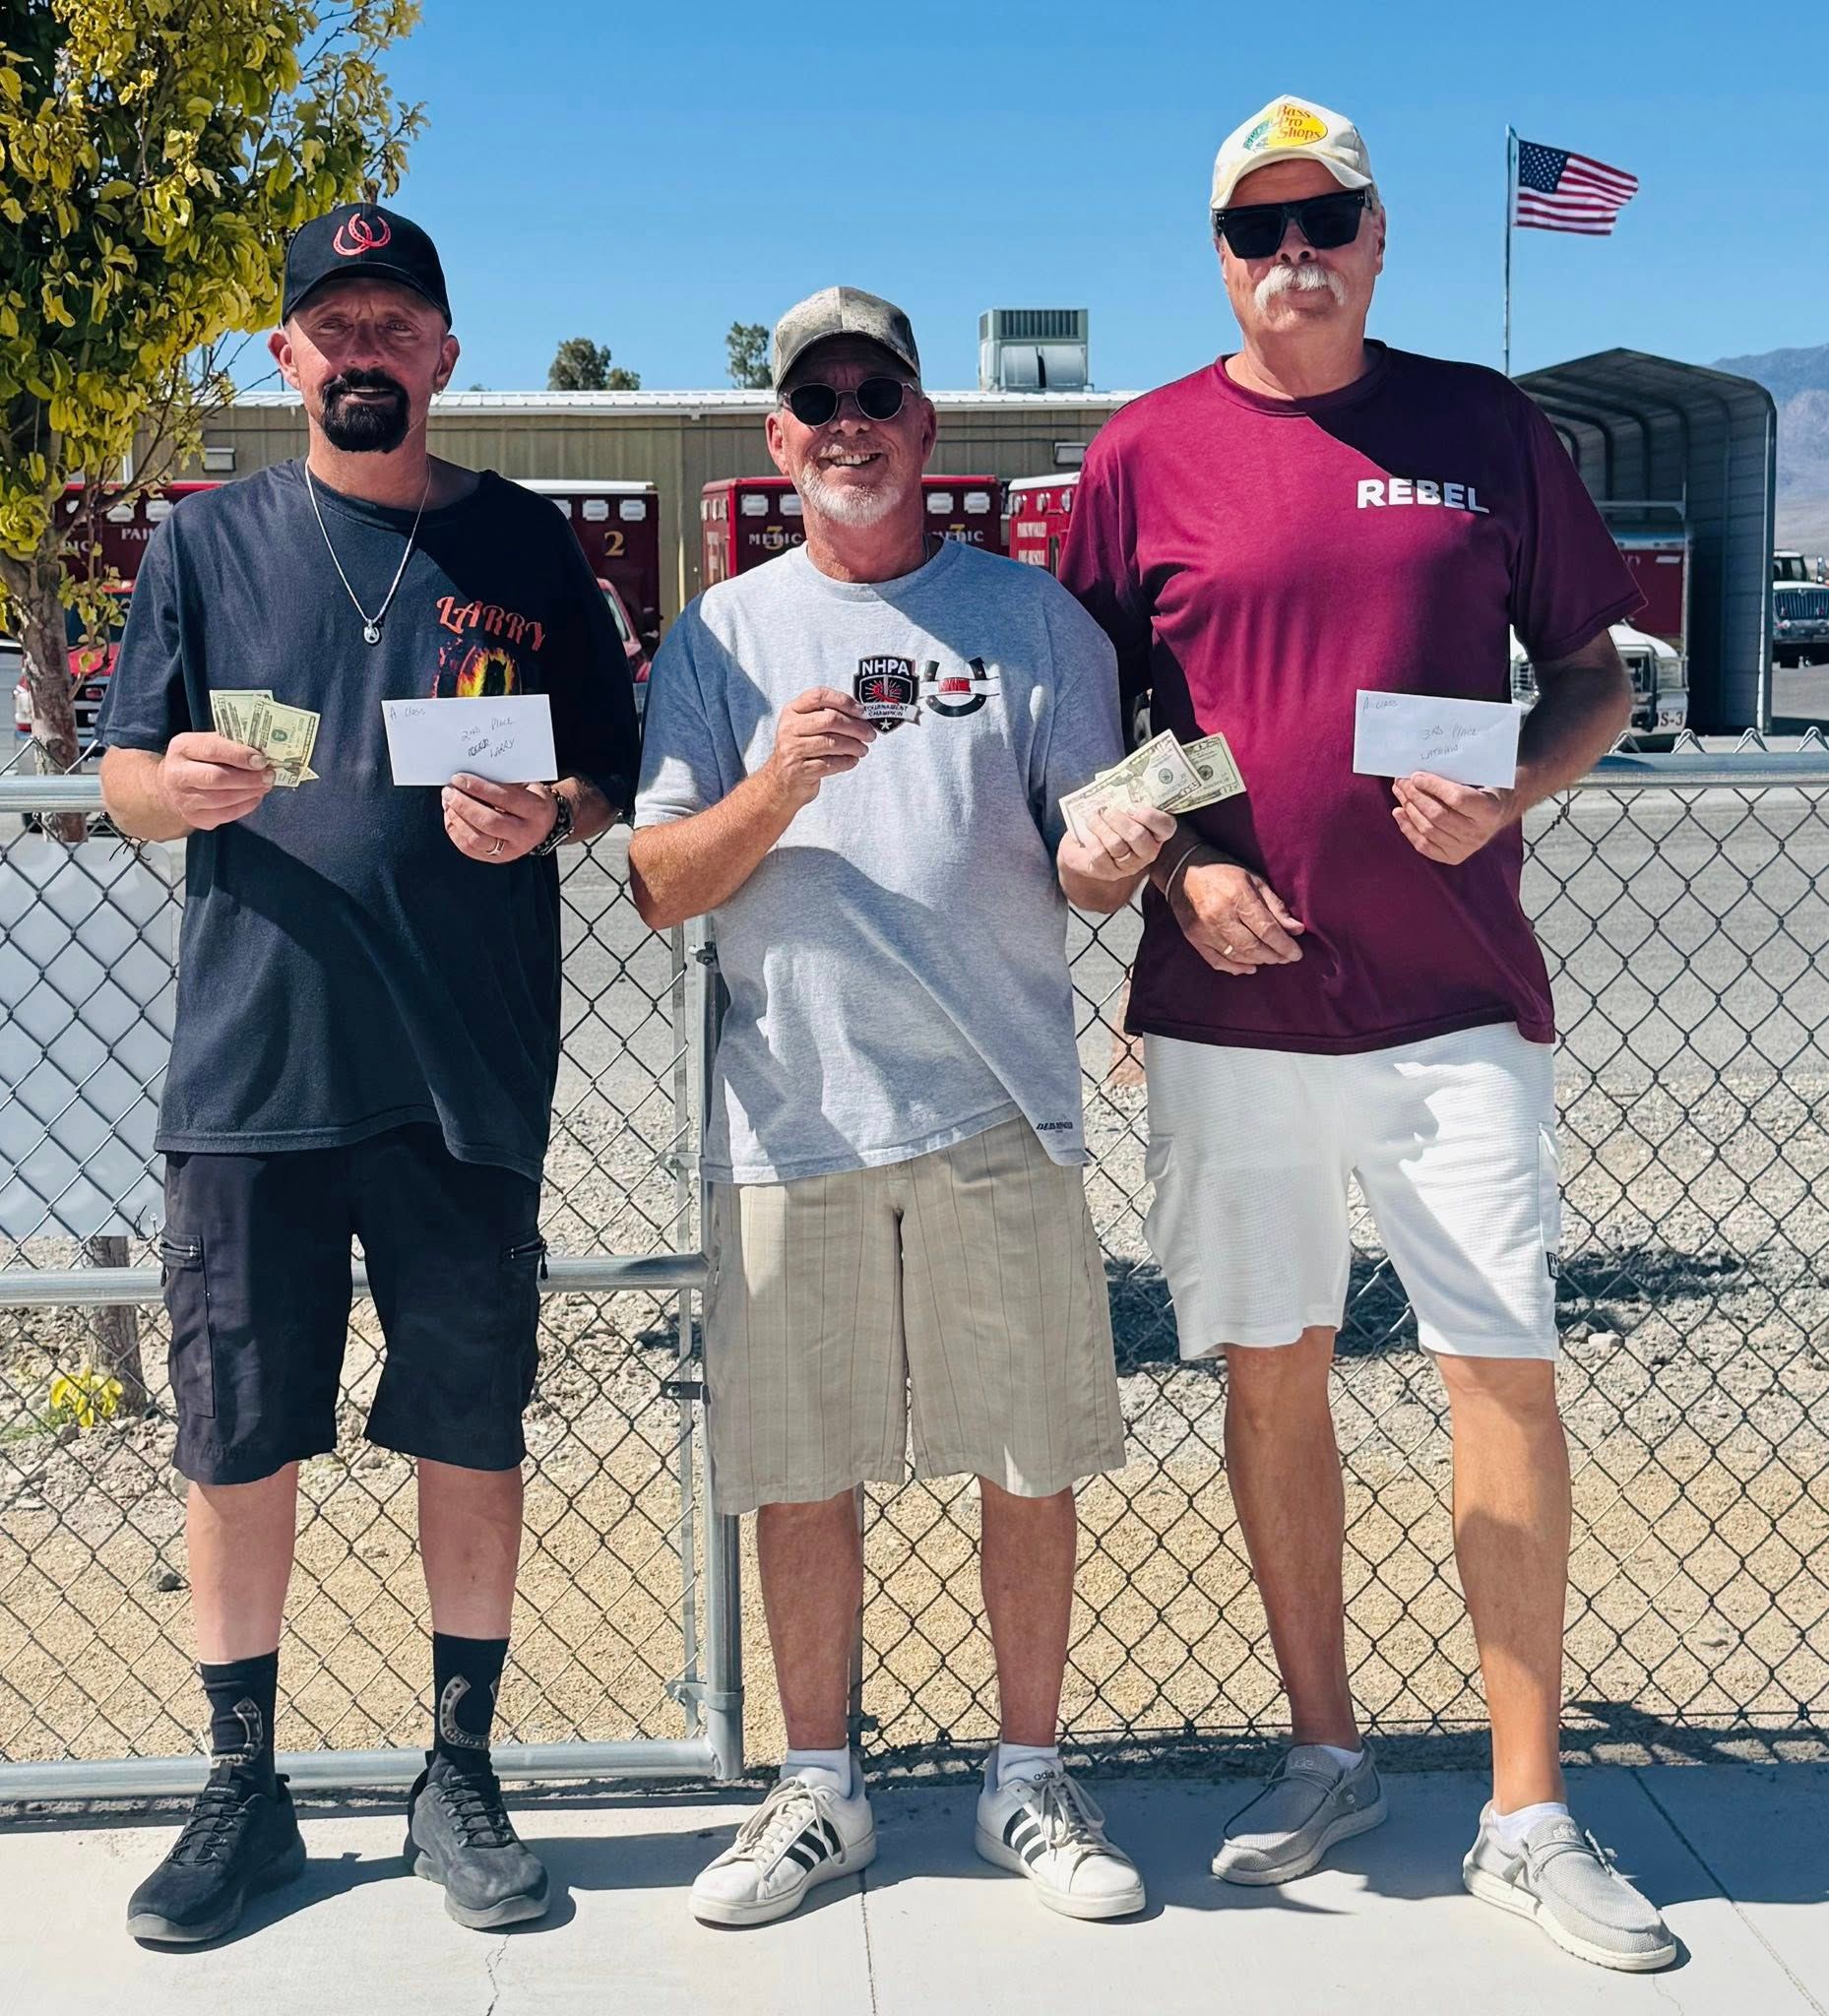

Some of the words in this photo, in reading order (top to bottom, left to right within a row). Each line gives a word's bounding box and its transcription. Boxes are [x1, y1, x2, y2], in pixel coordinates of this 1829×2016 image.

[1277, 105, 1311, 118] Bass
[1279, 117, 1302, 128] Pro
[1278, 127, 1321, 140] Shops
[1357, 477, 1490, 514] REBEL
[603, 531, 625, 556] 2
[748, 533, 803, 544] MEDIC
[436, 596, 546, 652] LARRY
[861, 659, 911, 676] NHPA
[389, 707, 398, 722] A
[1660, 711, 1684, 726] S-3
